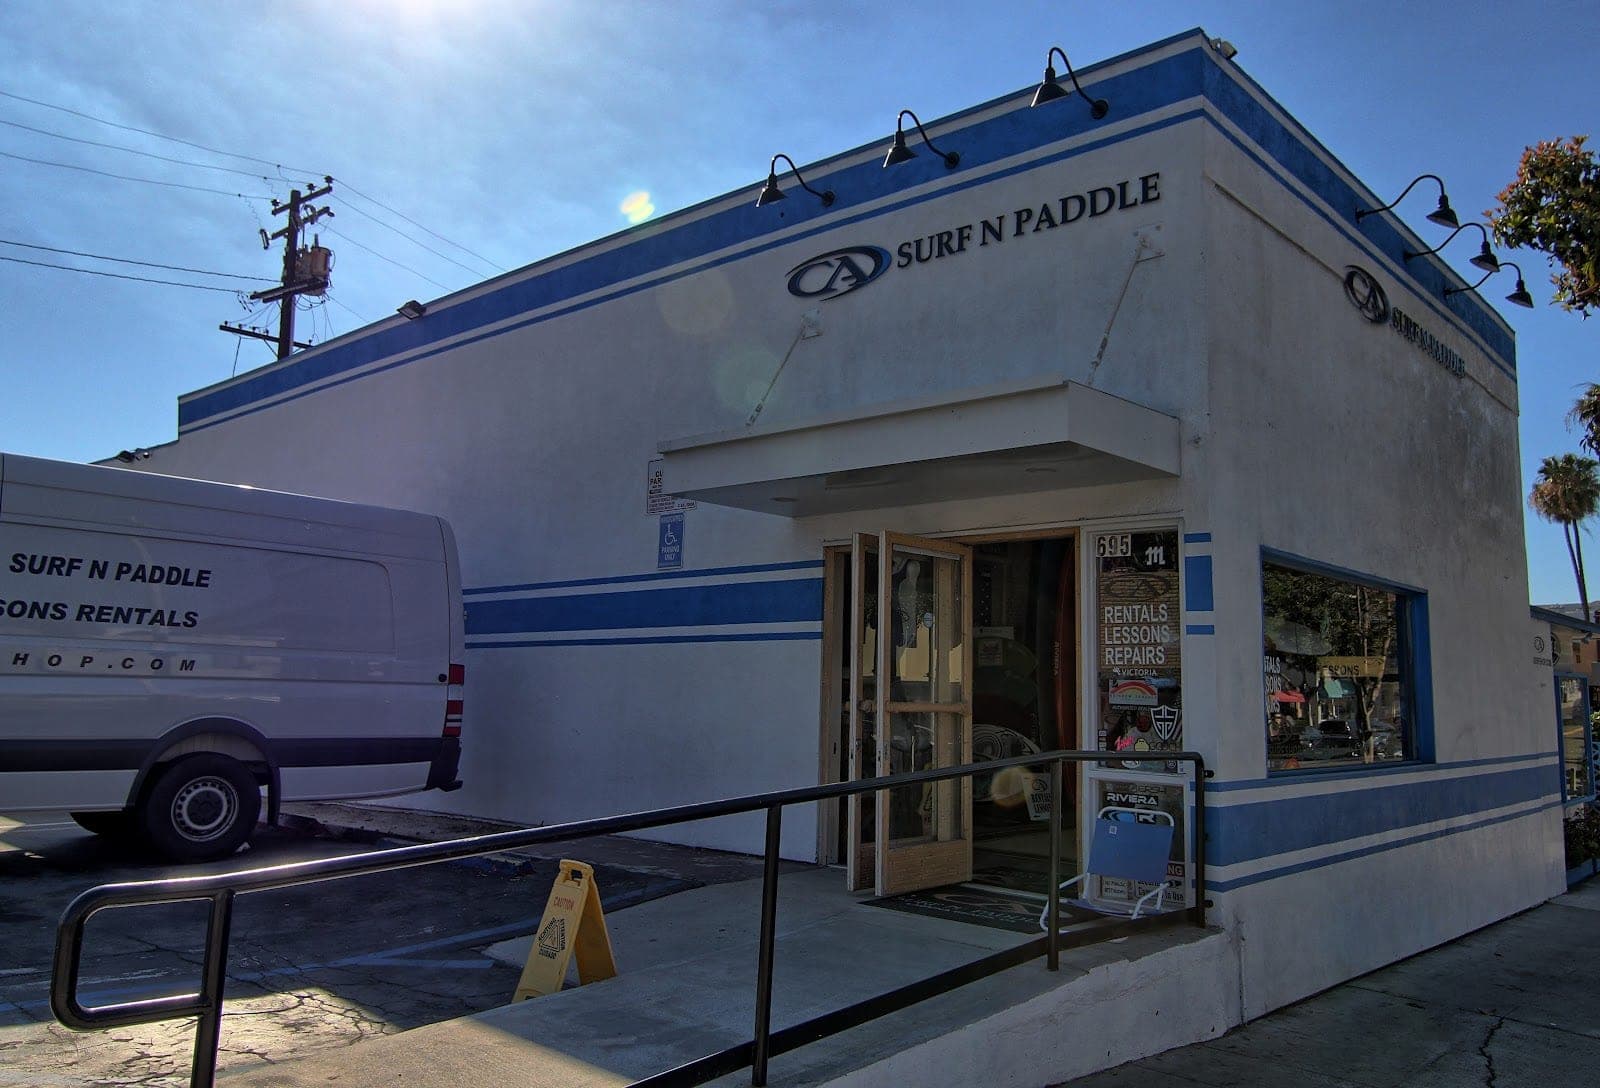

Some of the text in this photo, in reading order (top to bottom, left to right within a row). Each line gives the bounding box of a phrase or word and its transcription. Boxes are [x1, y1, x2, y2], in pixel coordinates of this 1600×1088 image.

[897, 225, 973, 269] SURF
[980, 216, 1005, 246] N
[1013, 172, 1161, 237] PADDLE
[1097, 536, 1129, 557] 695
[9, 552, 212, 588] SURF N PADDLE
[75, 604, 199, 628] RENTALS
[1104, 604, 1168, 624] RENTALS
[1104, 624, 1170, 645] LESSONS
[1105, 646, 1165, 665] REPAIRS
[1121, 667, 1158, 677] VICTORIA
[1106, 792, 1158, 805] RIVIERA
